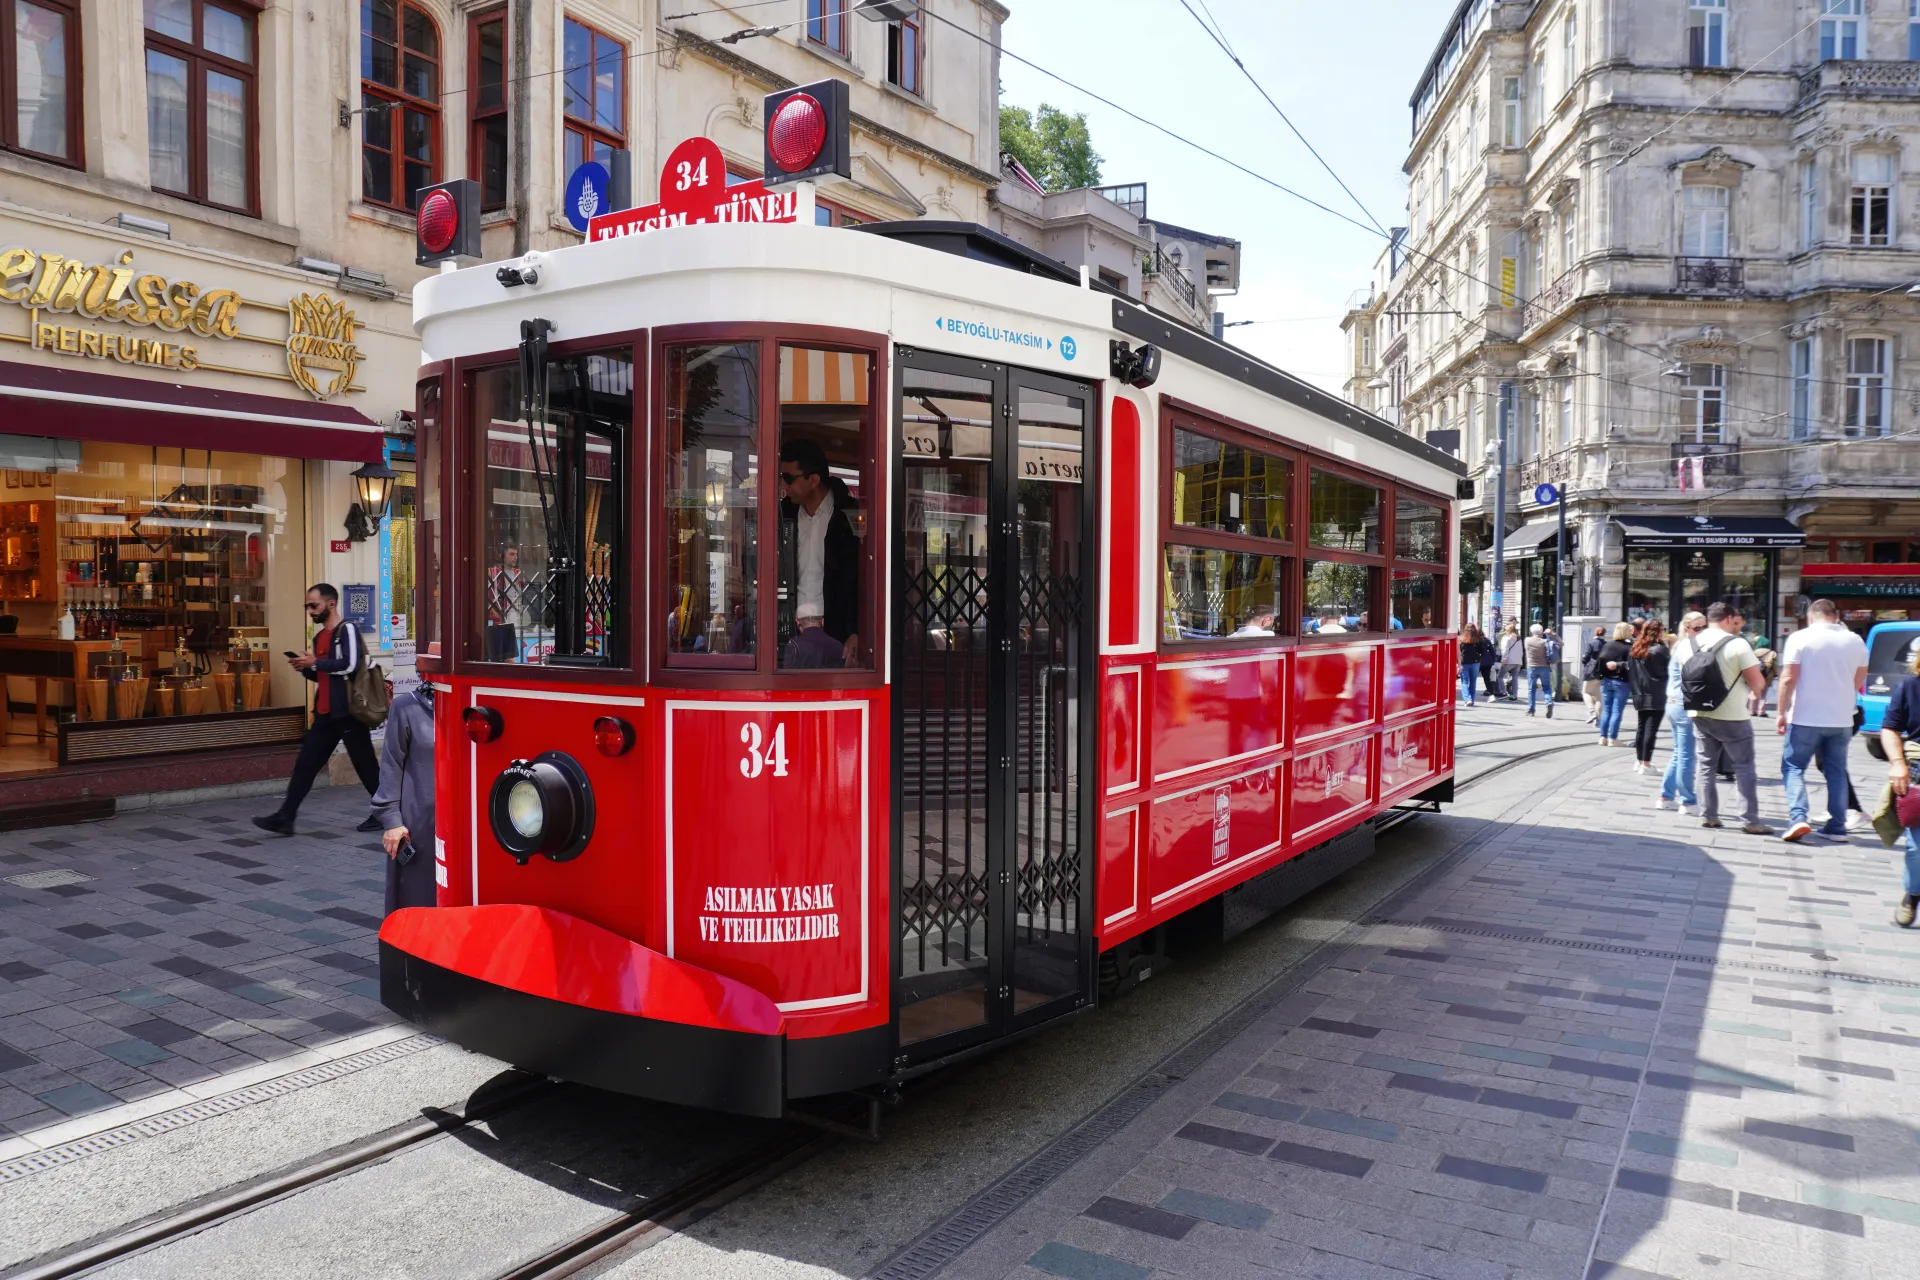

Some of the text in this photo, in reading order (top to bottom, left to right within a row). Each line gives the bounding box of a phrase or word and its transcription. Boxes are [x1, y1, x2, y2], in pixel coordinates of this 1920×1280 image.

[676, 157, 708, 191] 34
[0, 248, 242, 338] emissa
[37, 323, 199, 370] PERFUMES
[947, 318, 1043, 349] BEYOĞLU-TAKSİM
[1061, 341, 1074, 355] T2
[382, 591, 390, 644] CREAM
[740, 721, 789, 778] 34
[704, 884, 834, 912] ASILMAK YASAK
[699, 913, 839, 943] VE TEHLIKELIDIR
